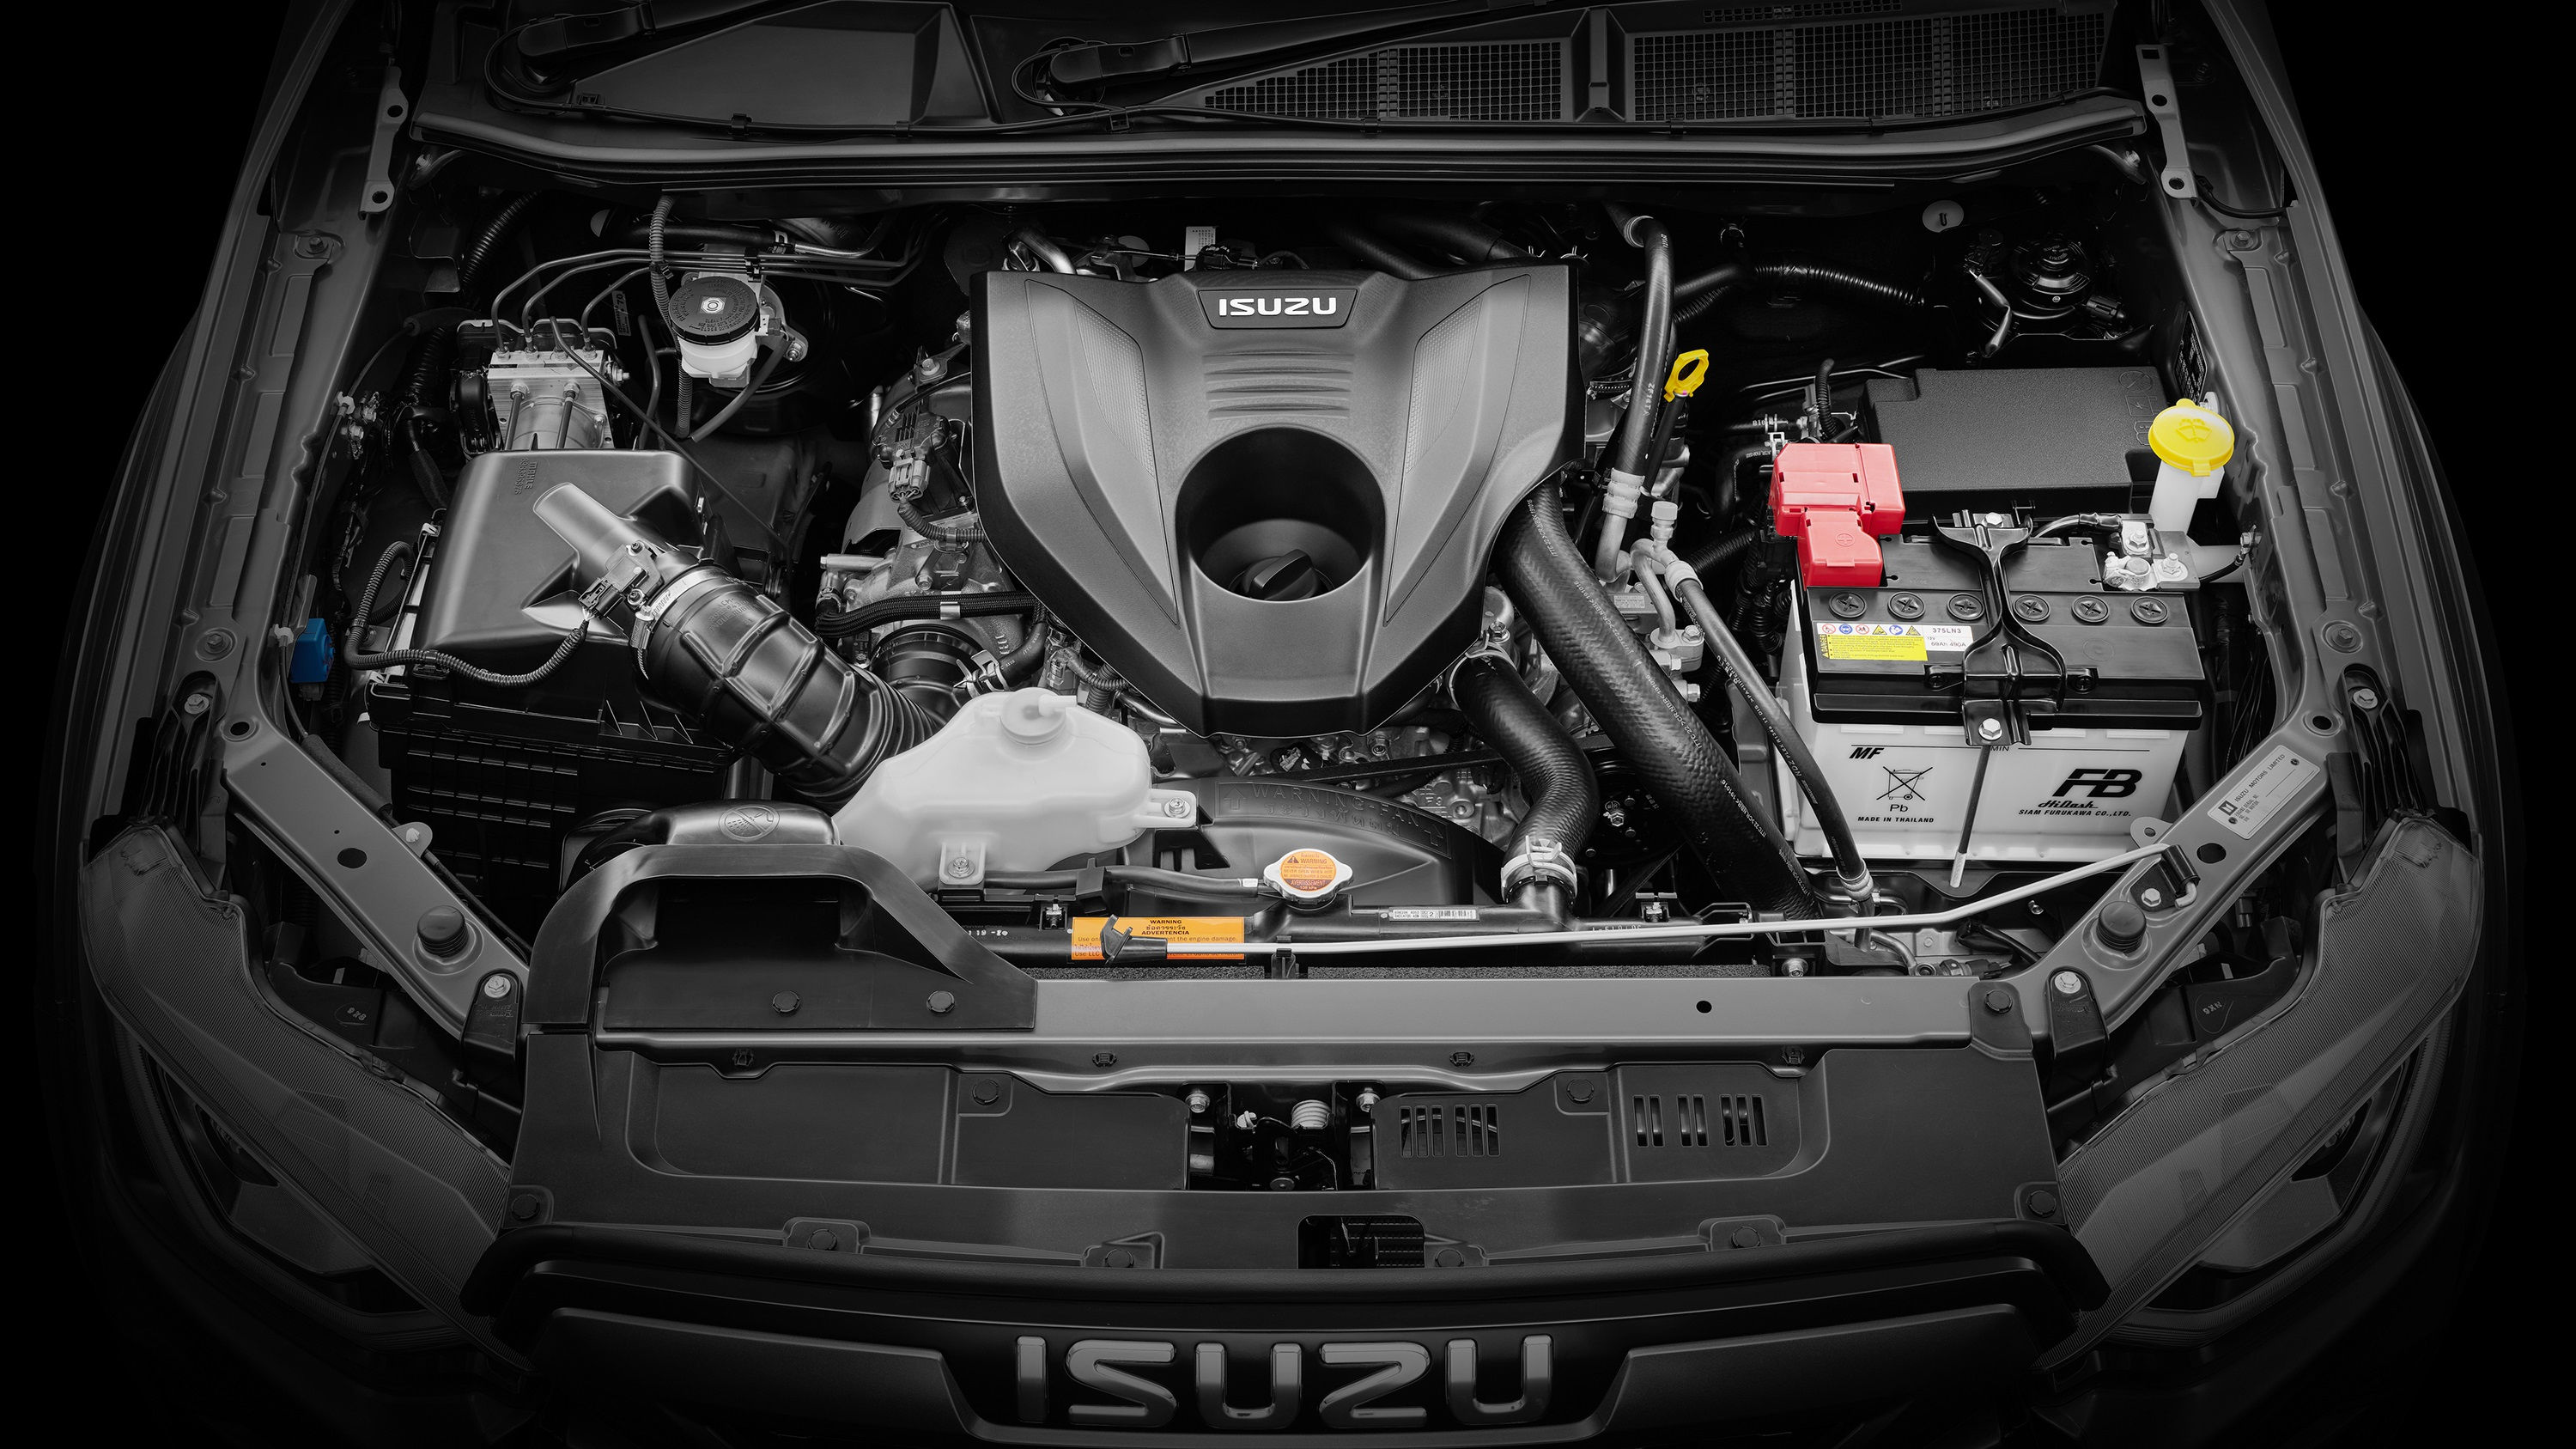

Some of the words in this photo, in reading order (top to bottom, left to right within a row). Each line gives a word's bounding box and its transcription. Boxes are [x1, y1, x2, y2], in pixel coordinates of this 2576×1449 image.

[1219, 297, 1337, 316] ISUZU
[526, 462, 538, 490] MAHLE
[1849, 746, 1885, 759] MF
[2052, 768, 2142, 798] FB
[2234, 788, 2250, 803] ISUZU
[2248, 770, 2269, 788] MOTORS
[2268, 754, 2286, 770] LIMITED
[1889, 804, 1909, 813] Pb
[1017, 1335, 1553, 1428] ISUZU
